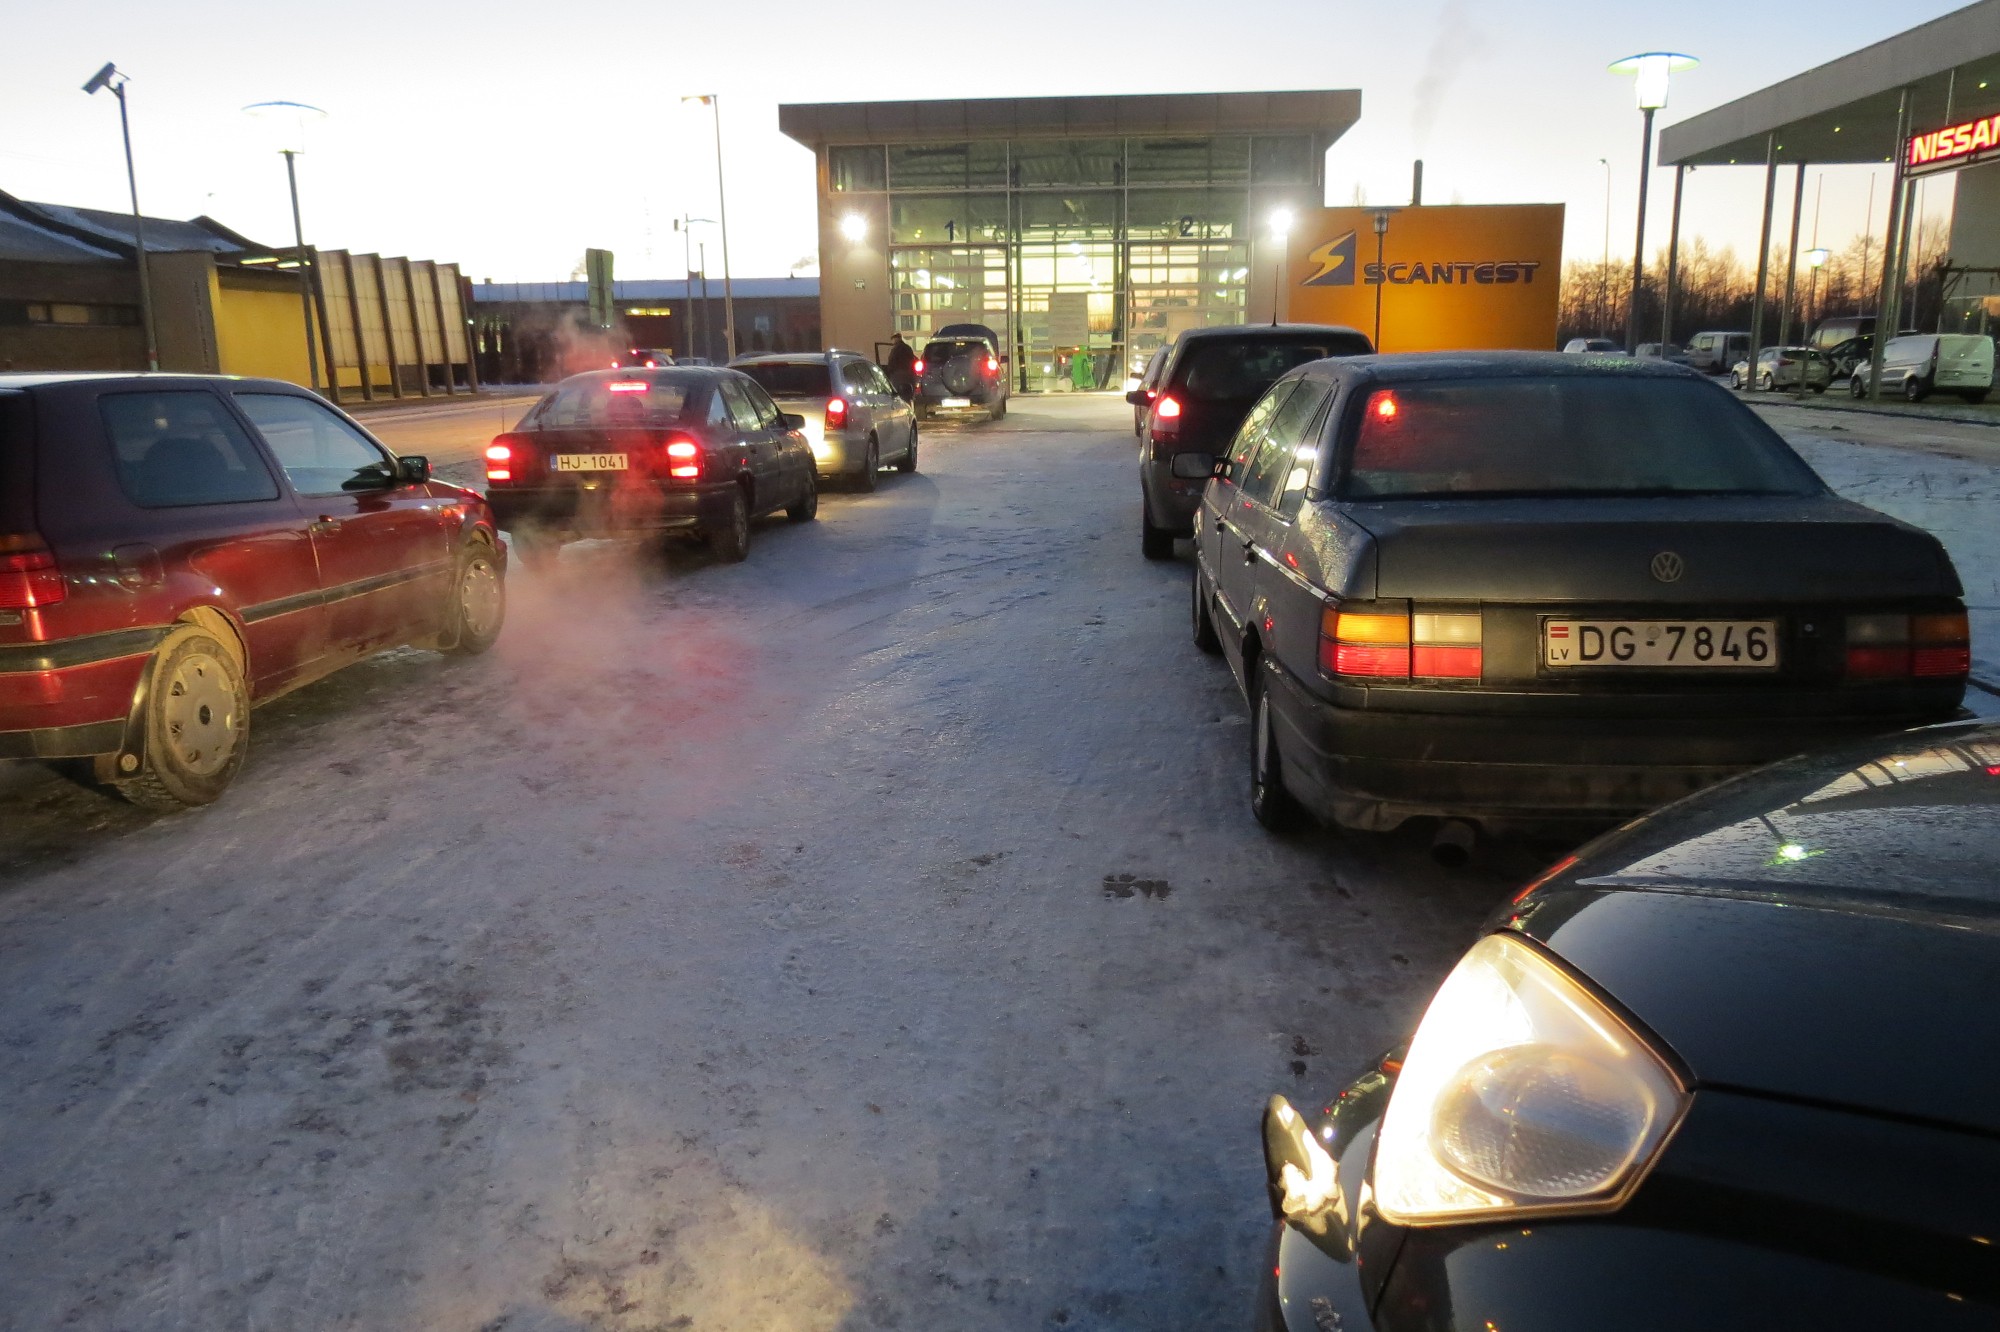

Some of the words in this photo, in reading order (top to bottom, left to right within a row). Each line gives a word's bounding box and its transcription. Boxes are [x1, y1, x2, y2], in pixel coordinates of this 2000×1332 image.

[944, 220, 954, 241] 1
[1180, 216, 1194, 237] 2
[1363, 261, 1541, 285] SCANTEST
[560, 456, 624, 469] HJ-1041
[1551, 648, 1569, 660] LV
[1578, 626, 1768, 662] DG-7846
